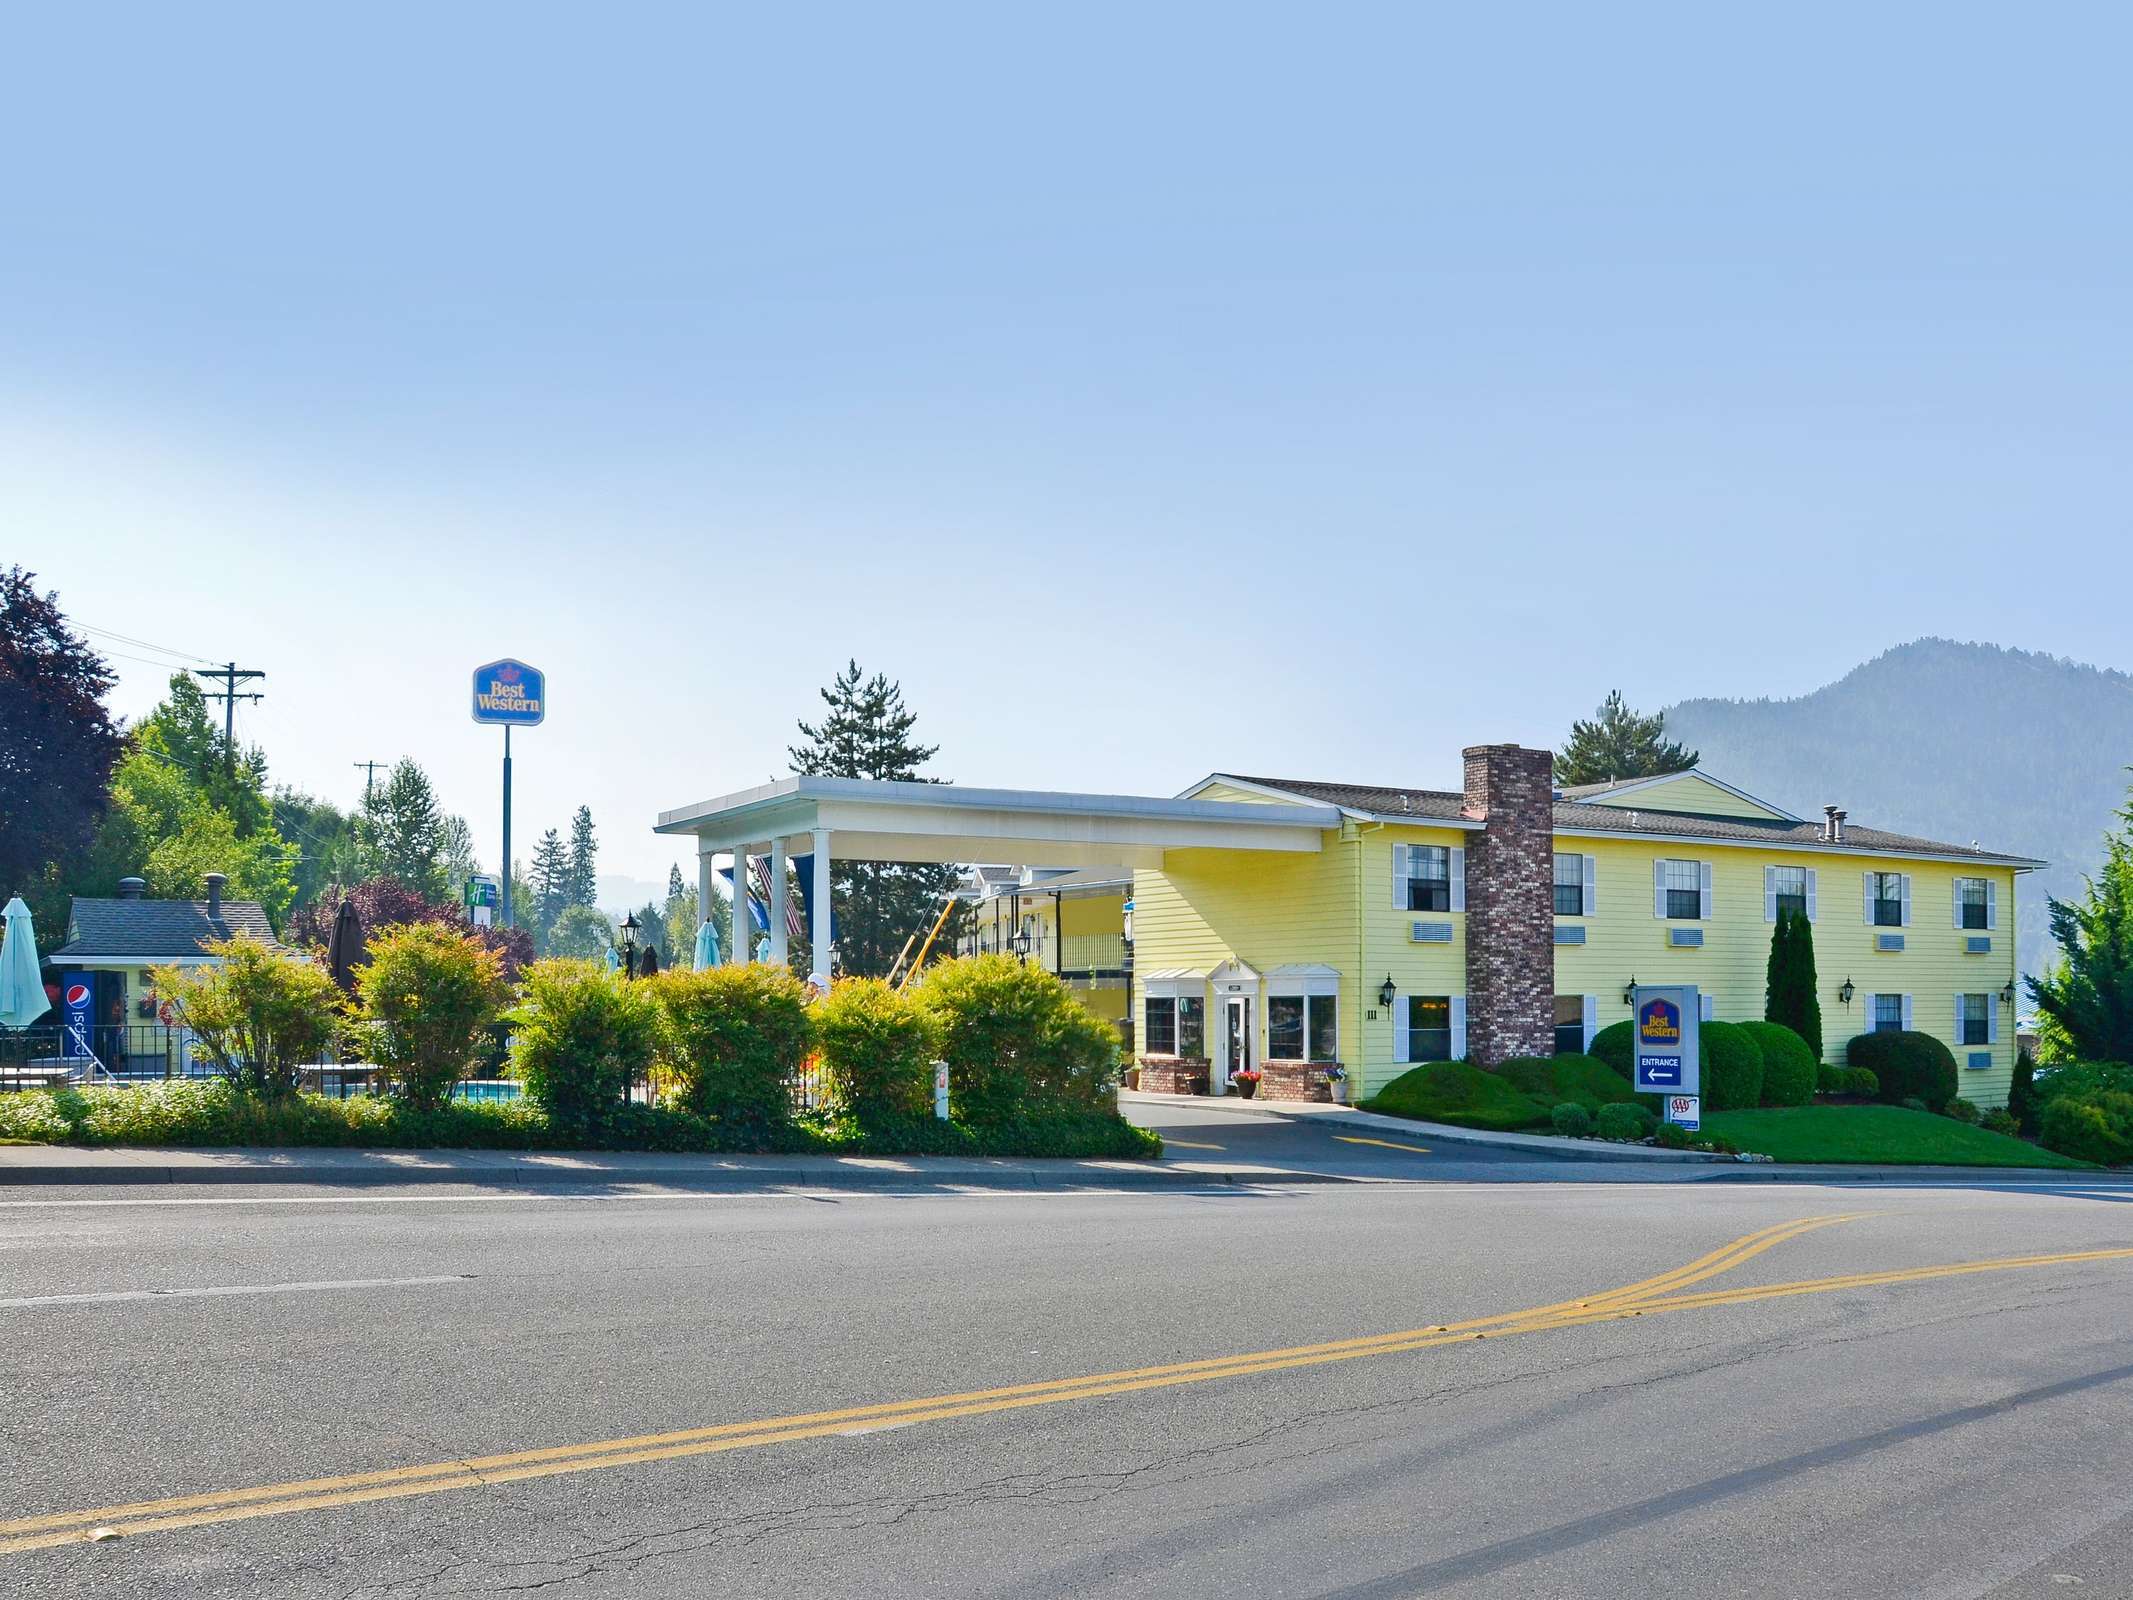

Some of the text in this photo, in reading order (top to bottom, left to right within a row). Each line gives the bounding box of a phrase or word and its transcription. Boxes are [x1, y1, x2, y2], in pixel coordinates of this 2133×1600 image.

[491, 681, 525, 698] Best
[478, 694, 540, 712] Western
[1649, 1015, 1668, 1027] Best
[1642, 1025, 1679, 1037] Western
[1641, 1058, 1679, 1067] ENTRANCE
